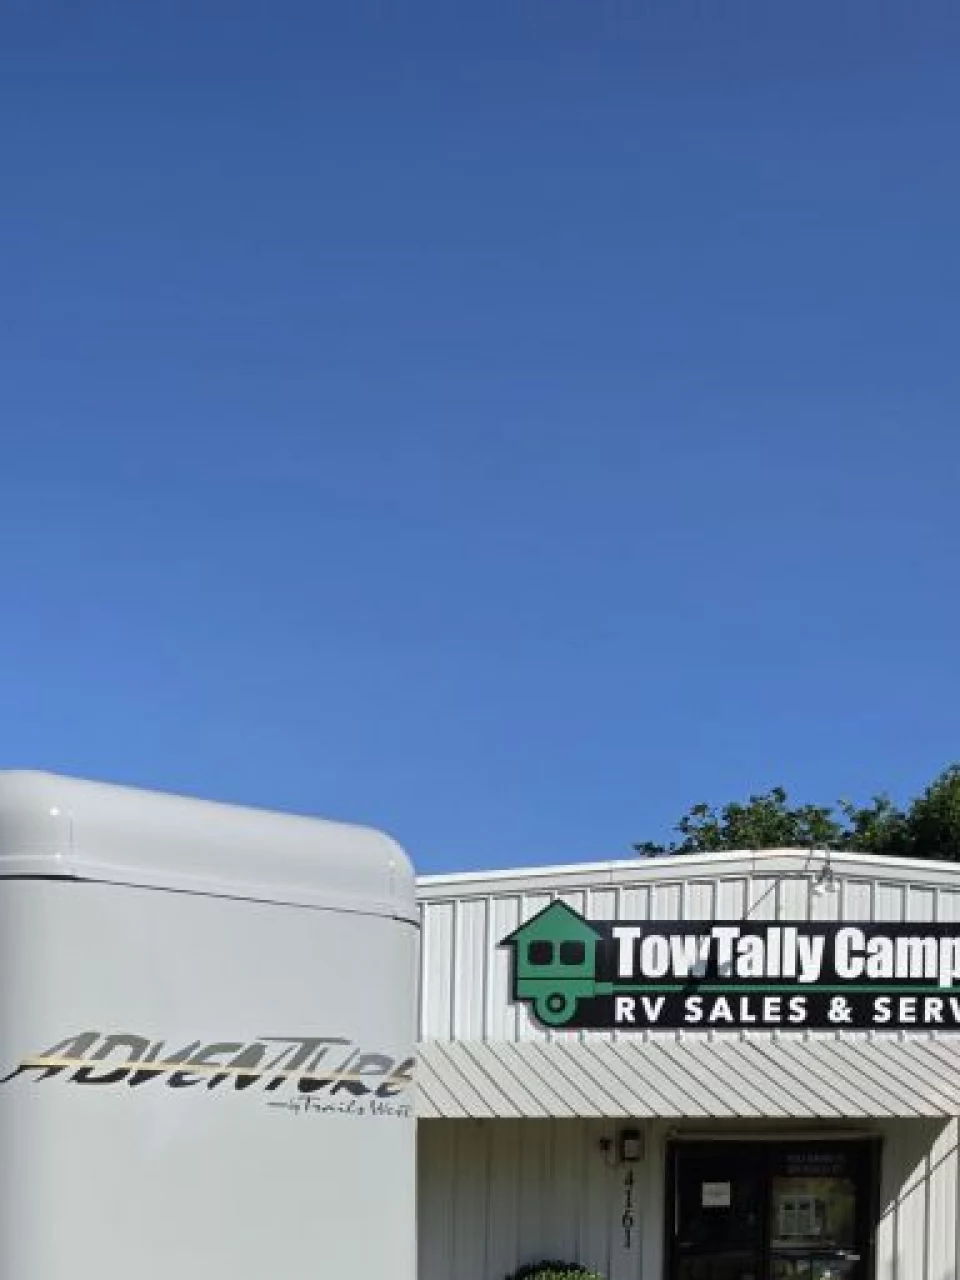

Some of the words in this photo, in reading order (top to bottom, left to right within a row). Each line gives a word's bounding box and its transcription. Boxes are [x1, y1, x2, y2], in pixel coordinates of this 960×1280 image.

[612, 926, 825, 983] TowTally
[834, 926, 960, 988] Camp
[615, 996, 666, 1023] RV
[683, 996, 808, 1023] SALES
[827, 996, 853, 1023] &
[622, 1169, 635, 1250] 4161
